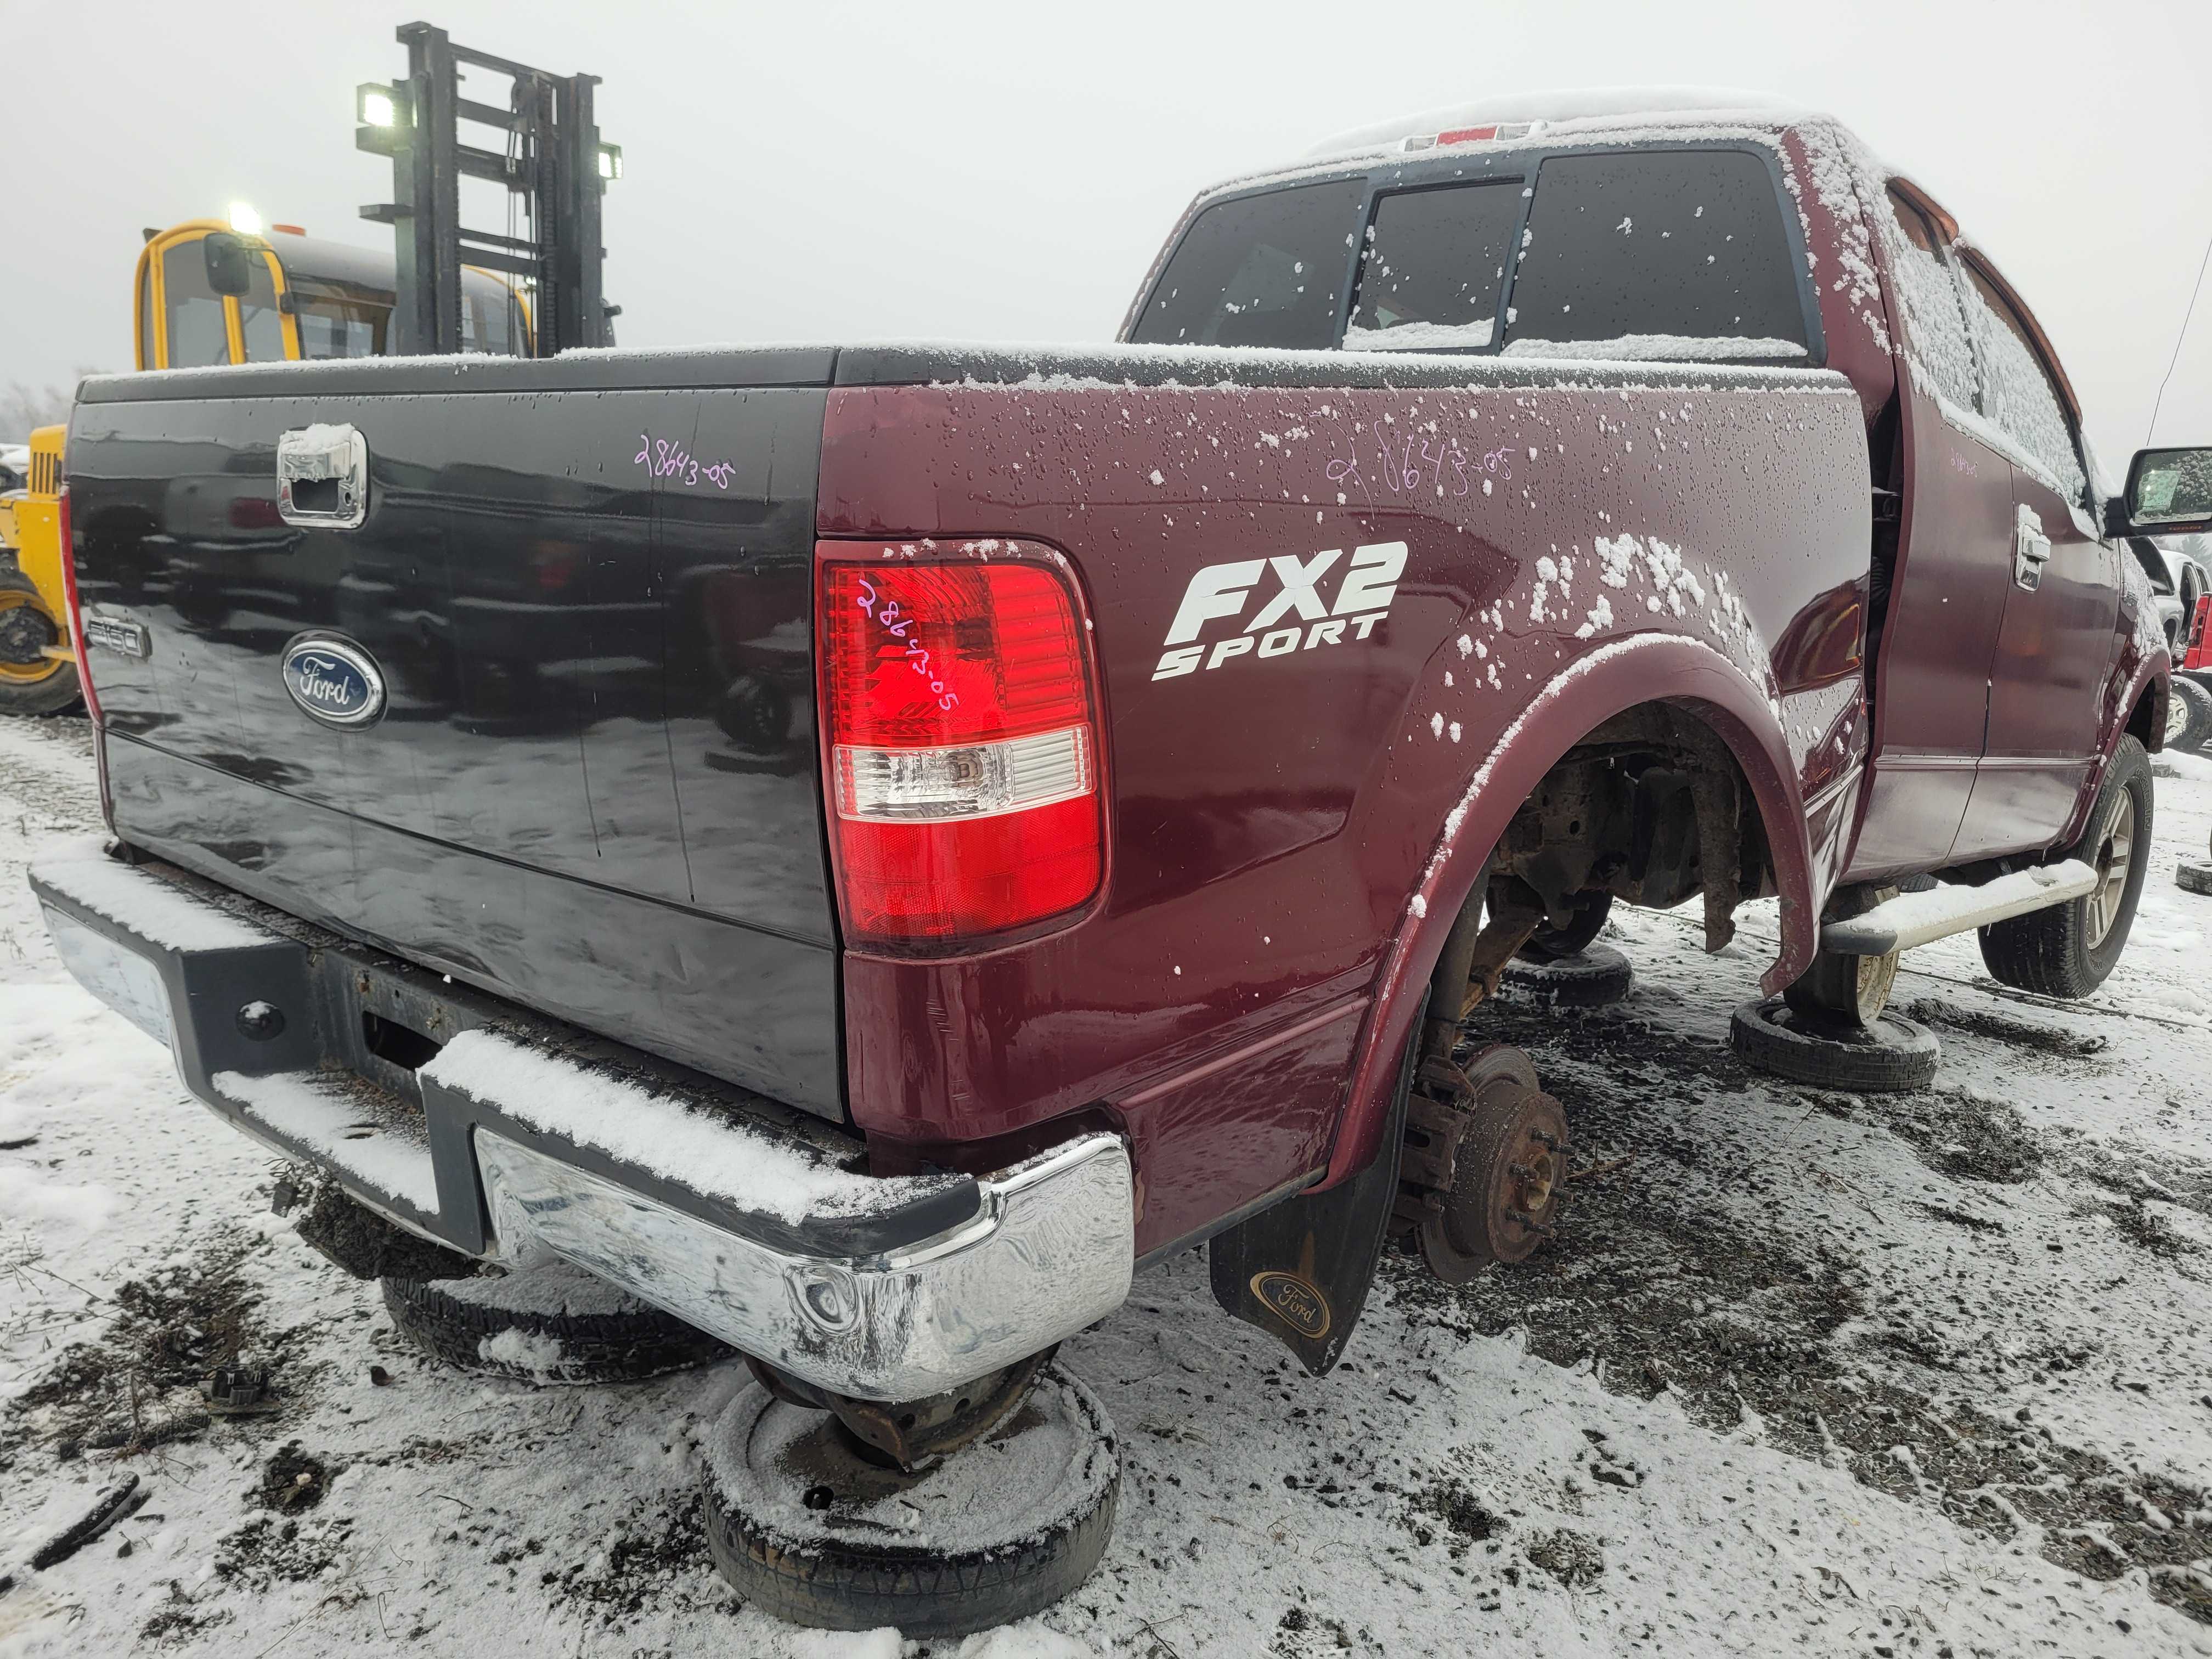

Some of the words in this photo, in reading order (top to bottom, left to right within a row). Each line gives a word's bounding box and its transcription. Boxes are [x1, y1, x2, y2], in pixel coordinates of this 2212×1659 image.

[634, 434, 736, 489] 28643-05
[1164, 541, 1408, 646] FX2
[857, 579, 960, 710] 28643-05
[1151, 611, 1389, 681] SPORT
[300, 656, 351, 705] Ford
[1278, 1284, 1317, 1323] Ford
